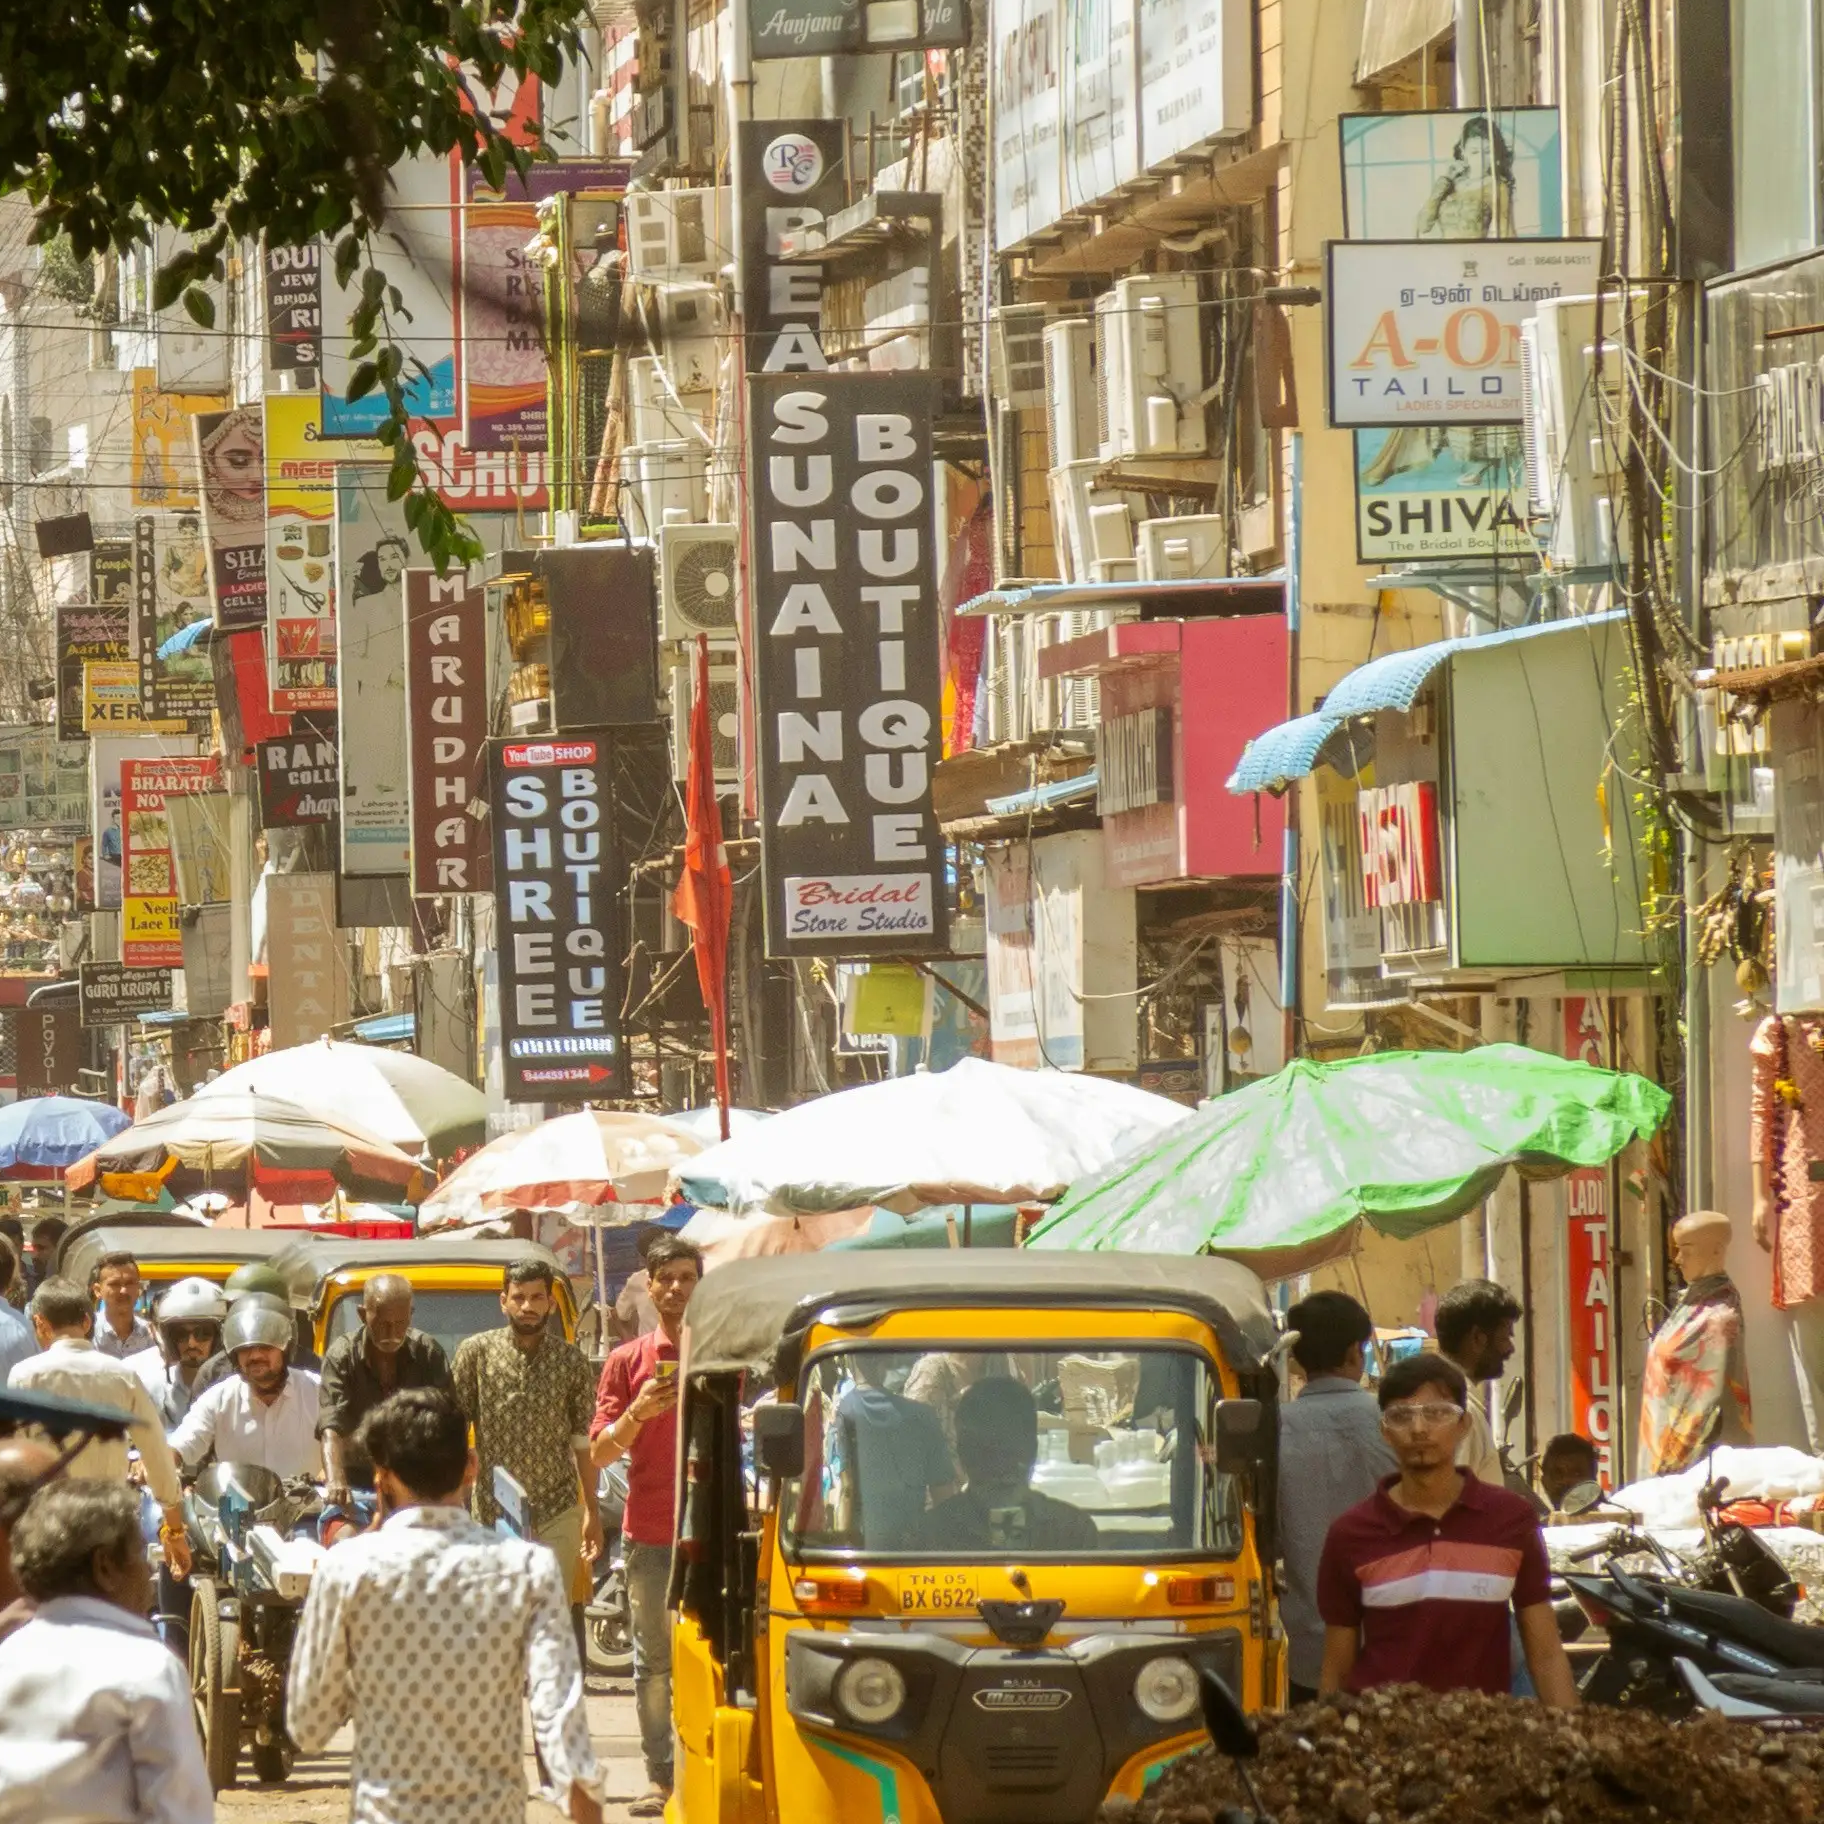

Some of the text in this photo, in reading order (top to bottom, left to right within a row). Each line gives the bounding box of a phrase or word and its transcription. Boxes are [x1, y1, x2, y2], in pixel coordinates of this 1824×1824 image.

[1352, 376, 1502, 396] TAILO
[1397, 400, 1442, 412] LADIES
[1387, 540, 1414, 552] The
[1420, 538, 1463, 551] Bridal
[770, 391, 929, 862] SUNAINA BOUTIQUE
[428, 575, 469, 888] MARUDHAR
[555, 745, 592, 761] SHOP
[505, 768, 606, 1029] SHREE BOUTIQUE
[797, 880, 922, 906] Bridal
[792, 907, 929, 933] Store Studio
[85, 982, 118, 999] GURU
[43, 1014, 55, 1084] Payal
[909, 1574, 967, 1585] TN 05
[903, 1588, 976, 1610] BX 6522
